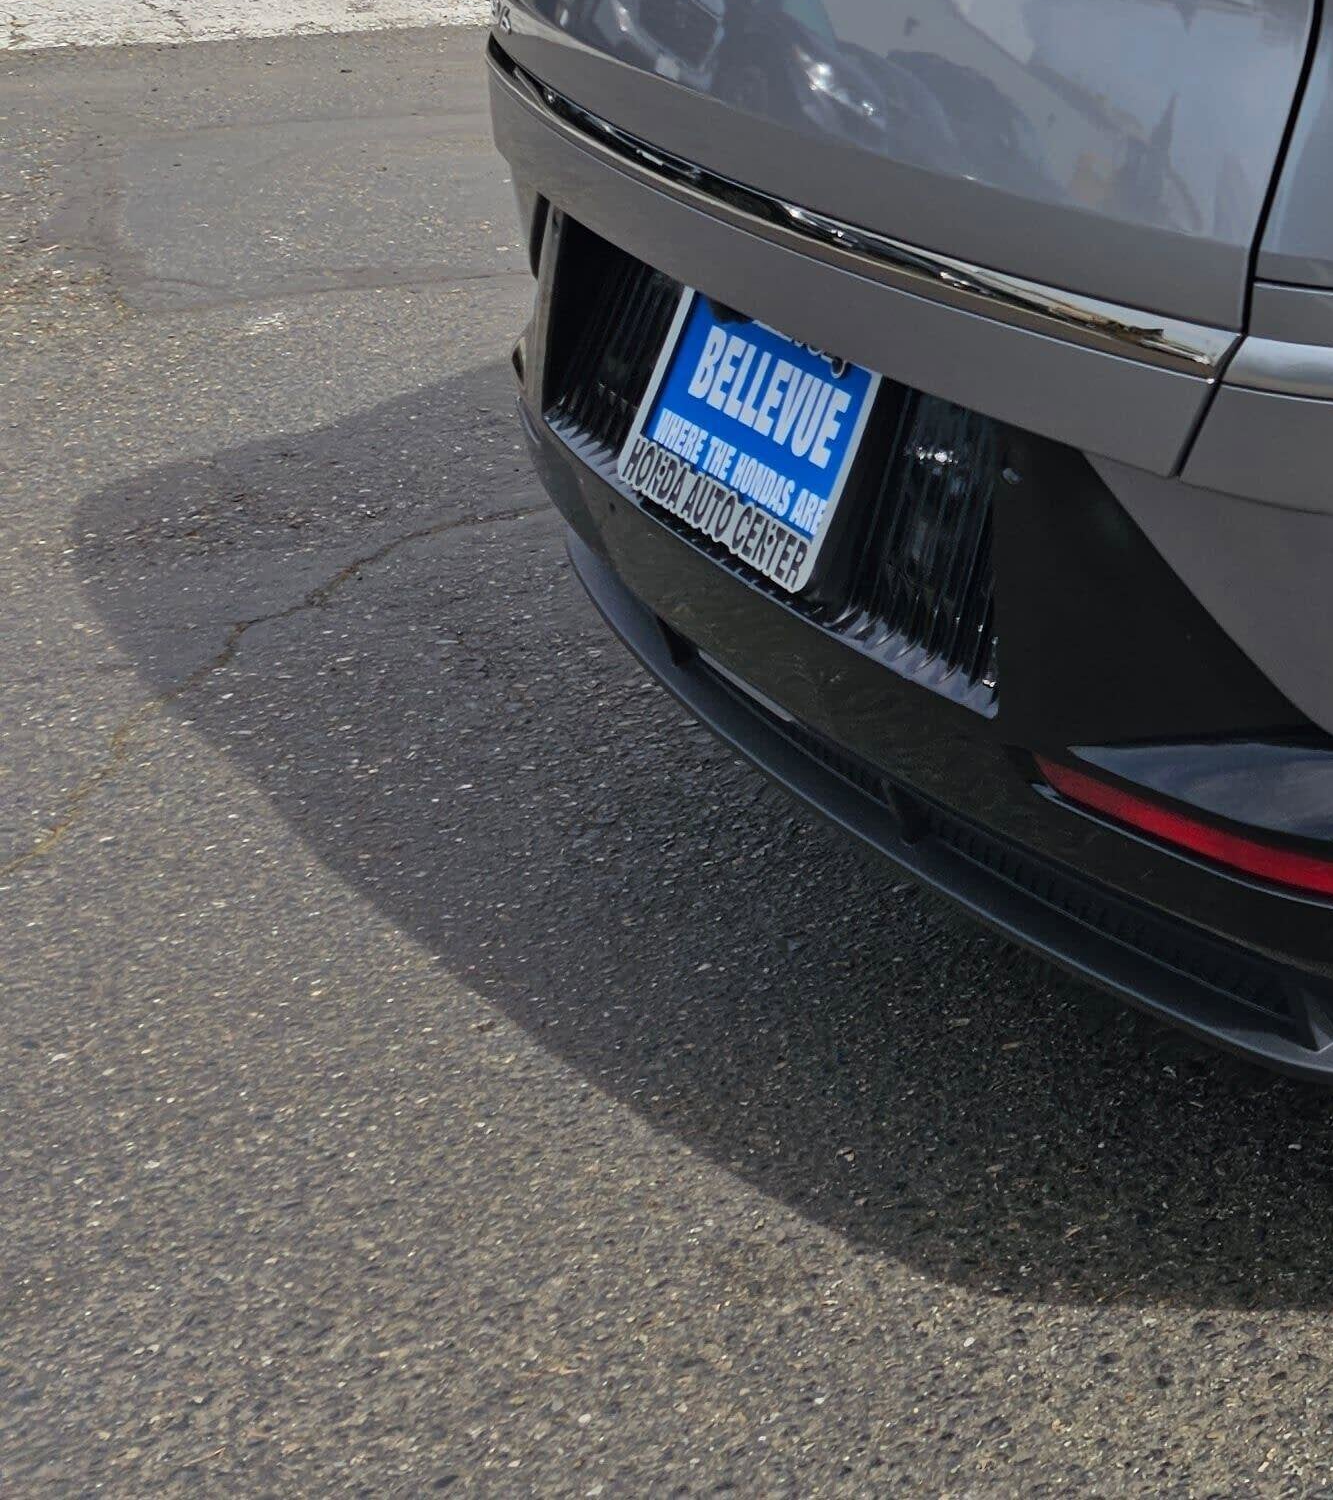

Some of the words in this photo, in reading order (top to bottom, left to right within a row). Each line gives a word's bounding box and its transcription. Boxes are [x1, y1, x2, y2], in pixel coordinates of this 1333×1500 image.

[688, 324, 852, 470] BELLEVUE
[622, 440, 690, 510] HONDA
[681, 472, 738, 539] AUTO
[731, 503, 810, 584] CENTER
[652, 407, 709, 466] WHERE
[702, 434, 738, 481] THE
[730, 452, 796, 518] HONDAS
[789, 487, 829, 536] ARE
